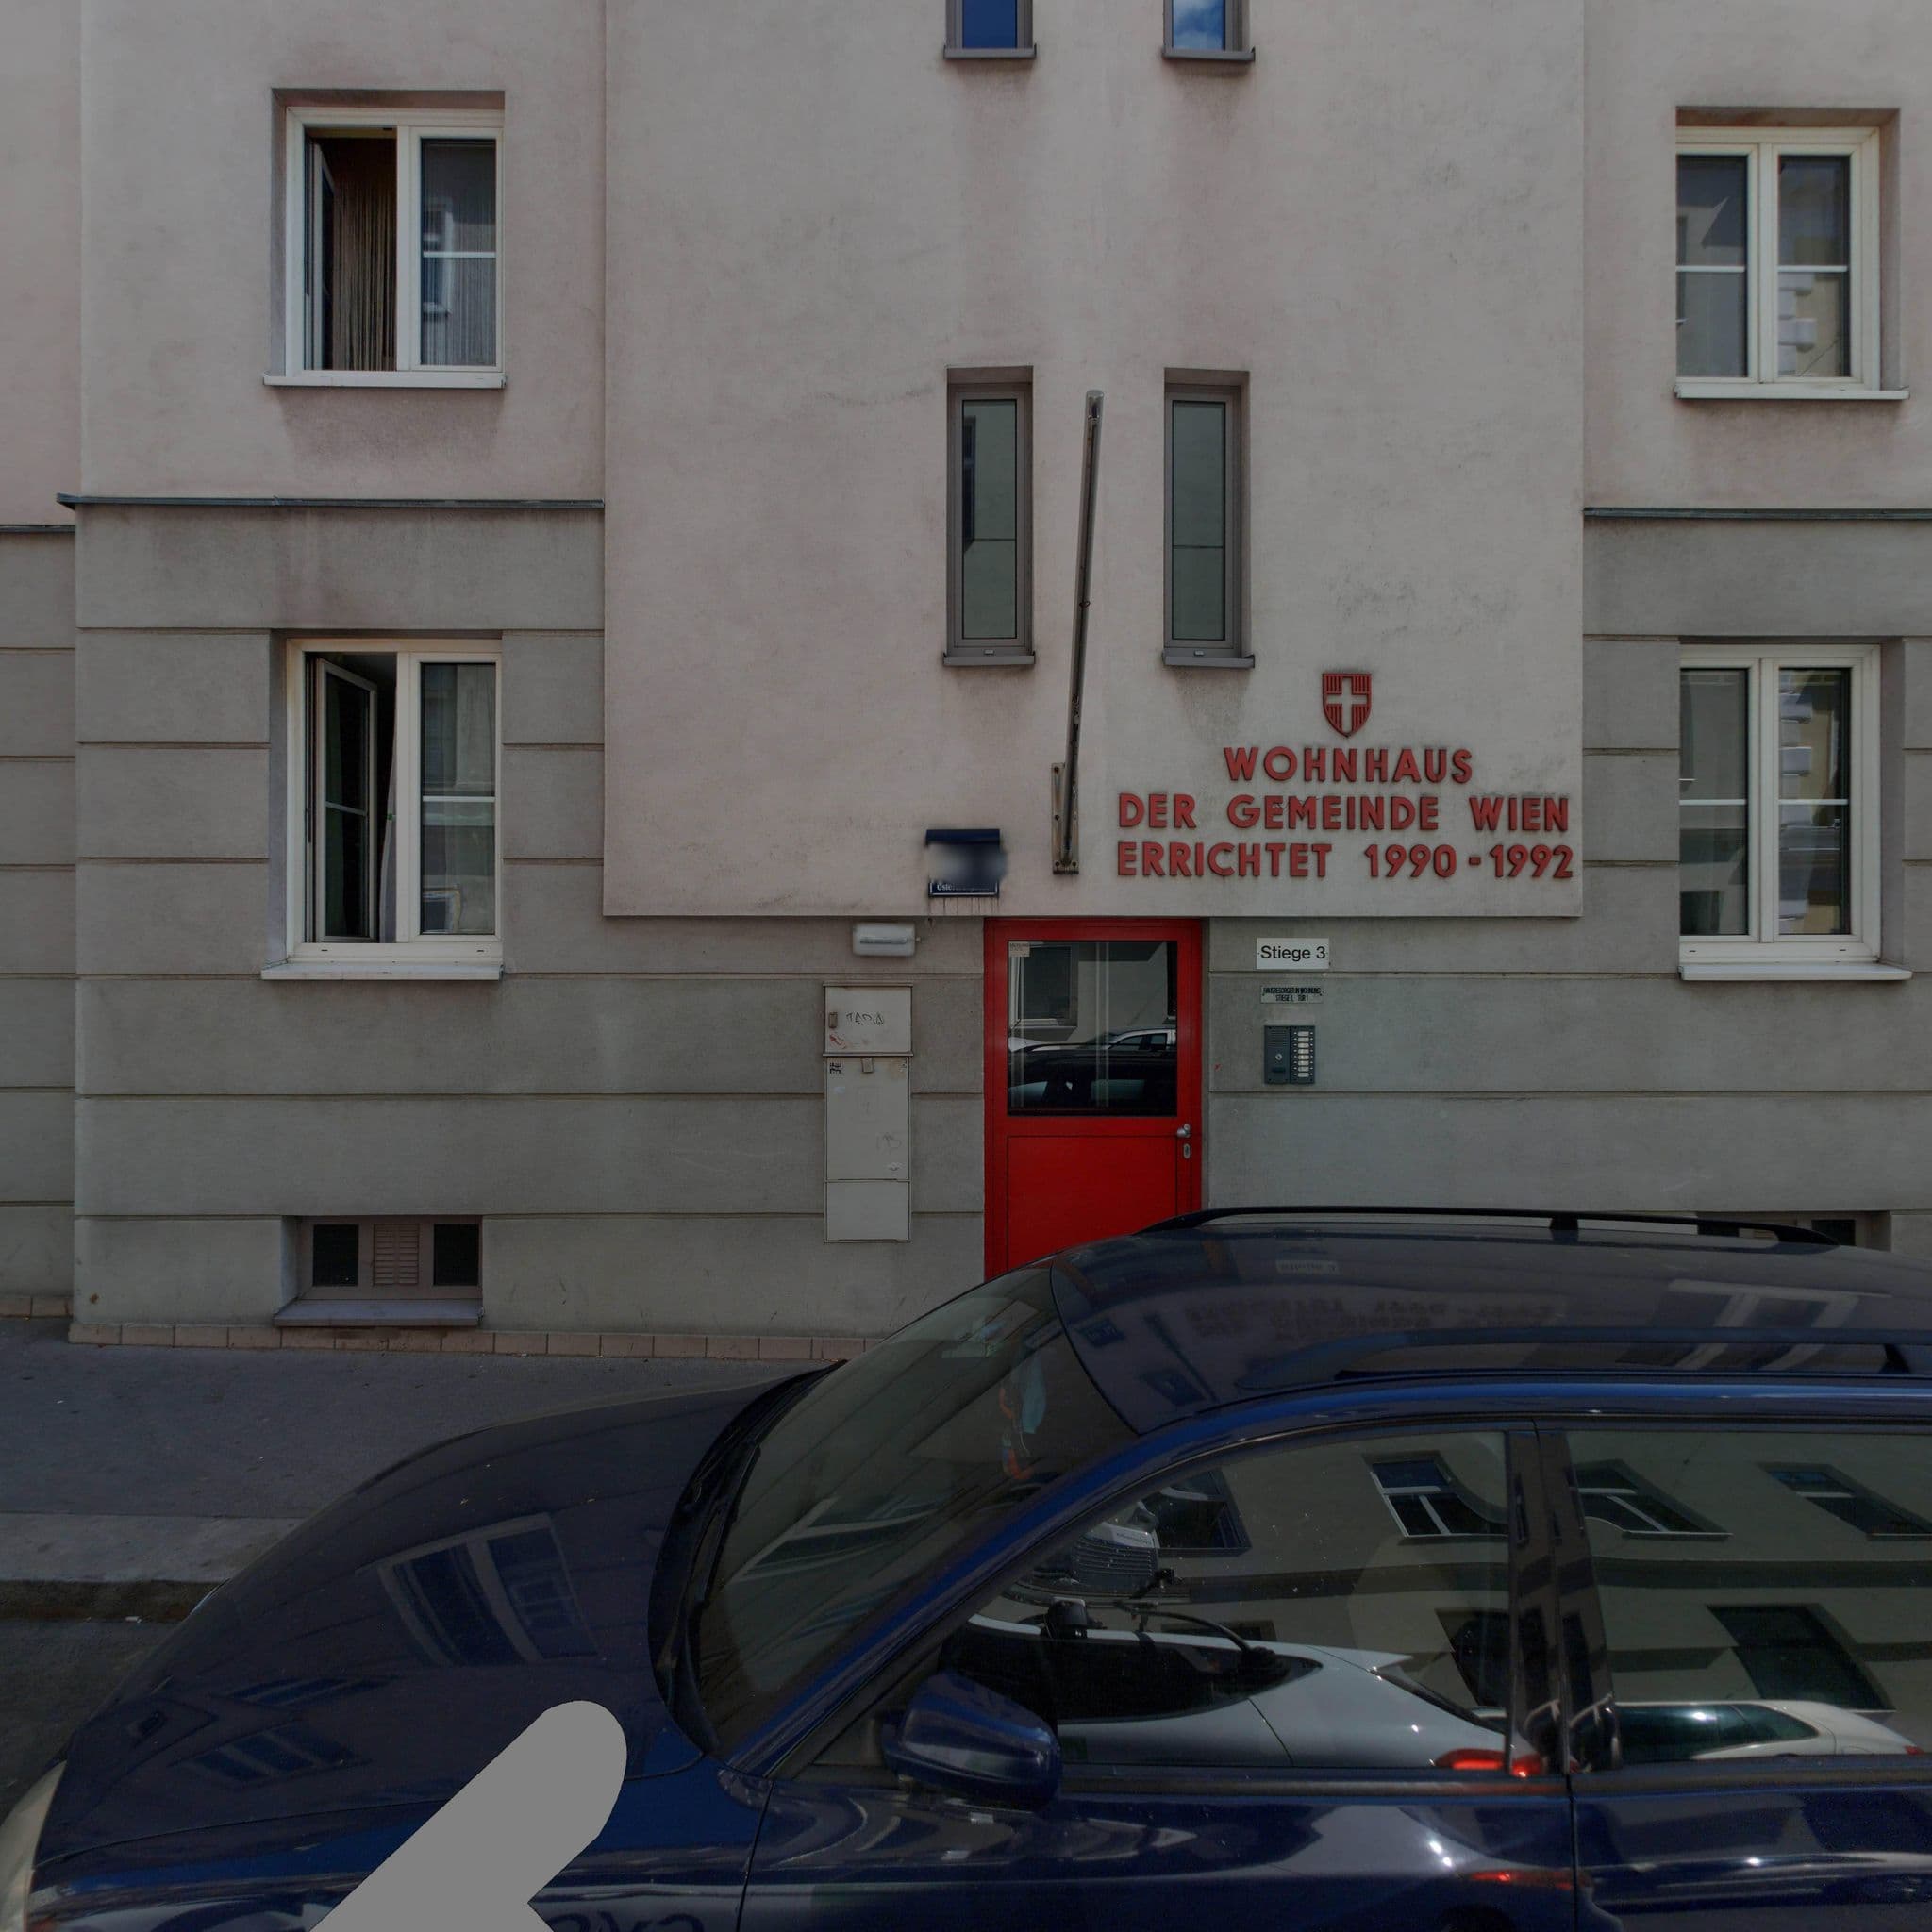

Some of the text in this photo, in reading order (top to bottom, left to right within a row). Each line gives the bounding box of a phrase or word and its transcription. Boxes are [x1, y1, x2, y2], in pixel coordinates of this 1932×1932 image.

[1224, 746, 1473, 783] WOHNHAUS
[1118, 792, 1569, 831] DER GEMEINDE WIEN
[1117, 841, 1333, 877] ERRICHTET
[1260, 945, 1326, 961] Stiege 3
